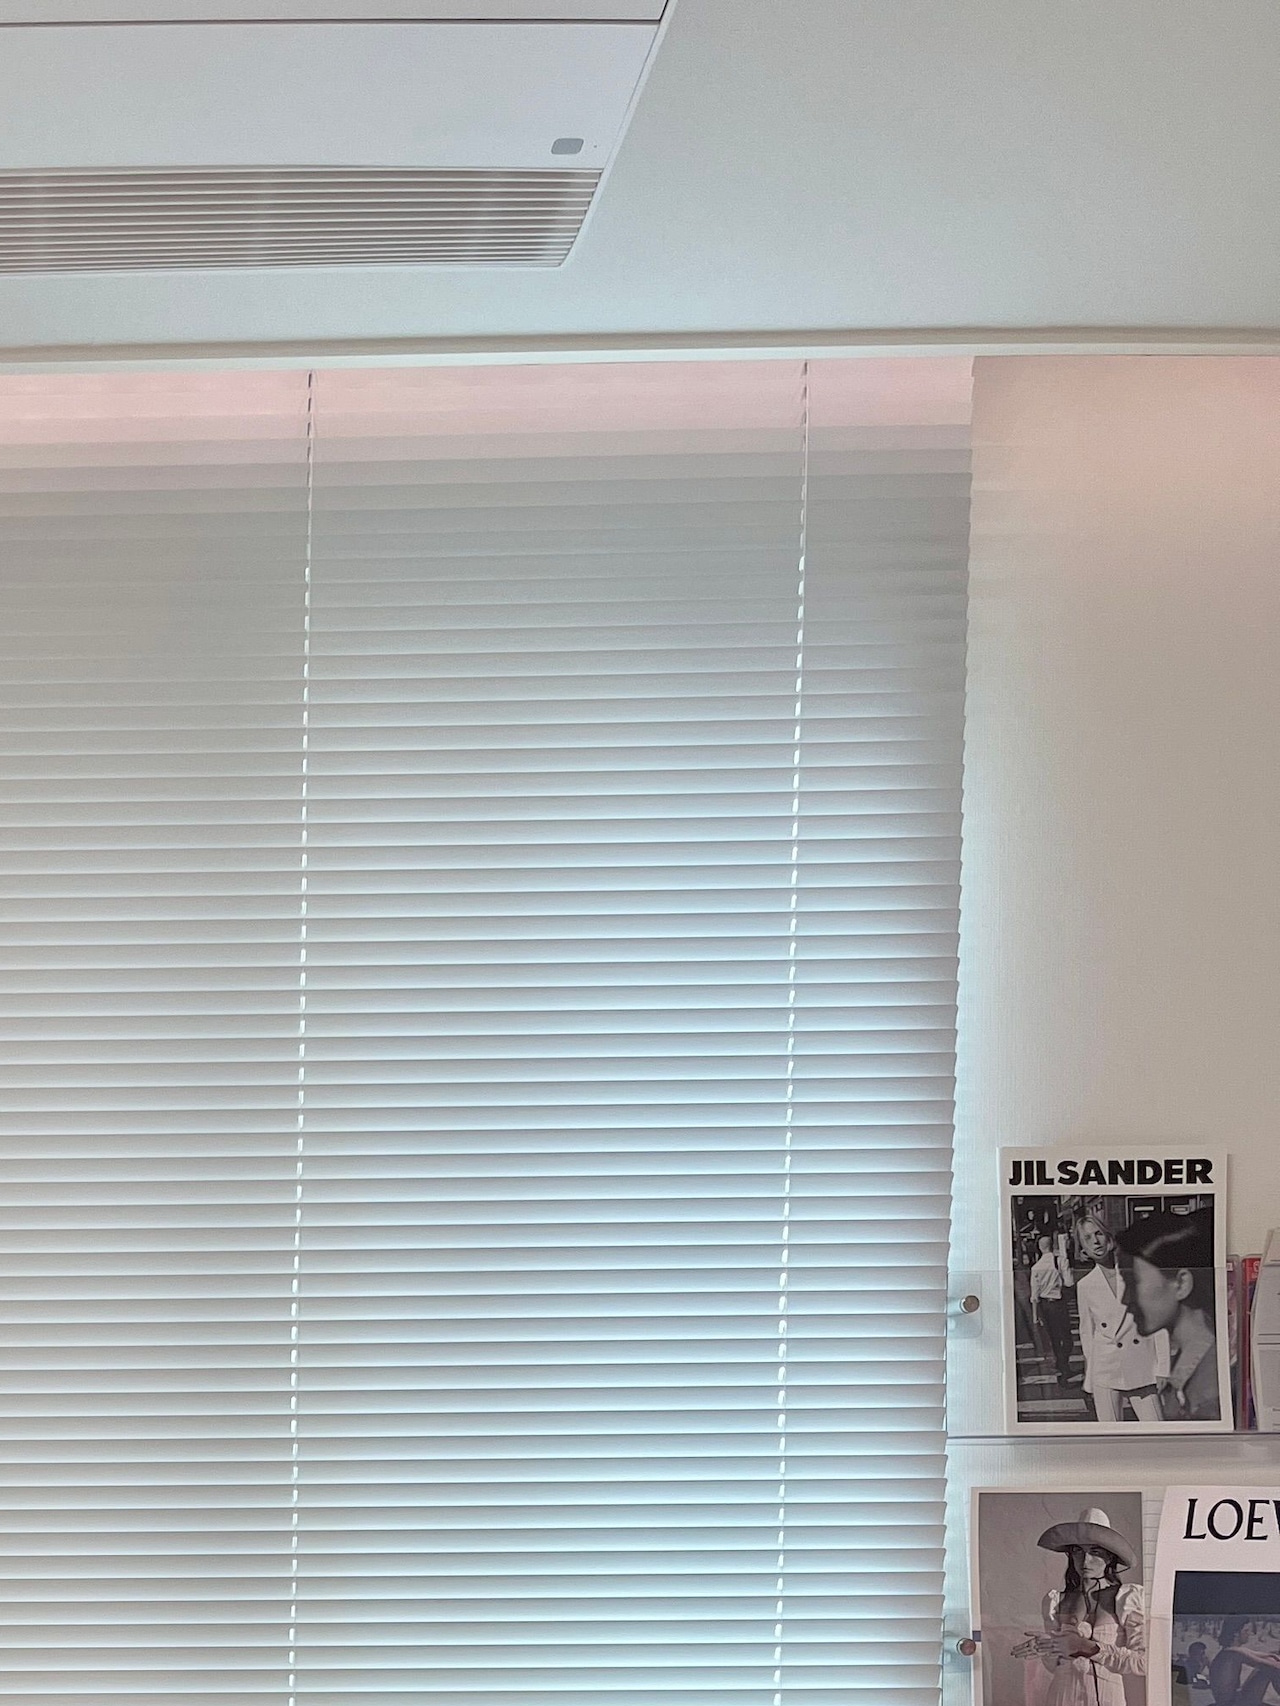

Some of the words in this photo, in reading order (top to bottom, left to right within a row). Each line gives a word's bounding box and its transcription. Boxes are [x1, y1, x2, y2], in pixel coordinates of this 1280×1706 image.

[1009, 1160, 1054, 1186] JIL
[1057, 1158, 1214, 1186] SANDER
[1182, 1498, 1280, 1540] LOE
